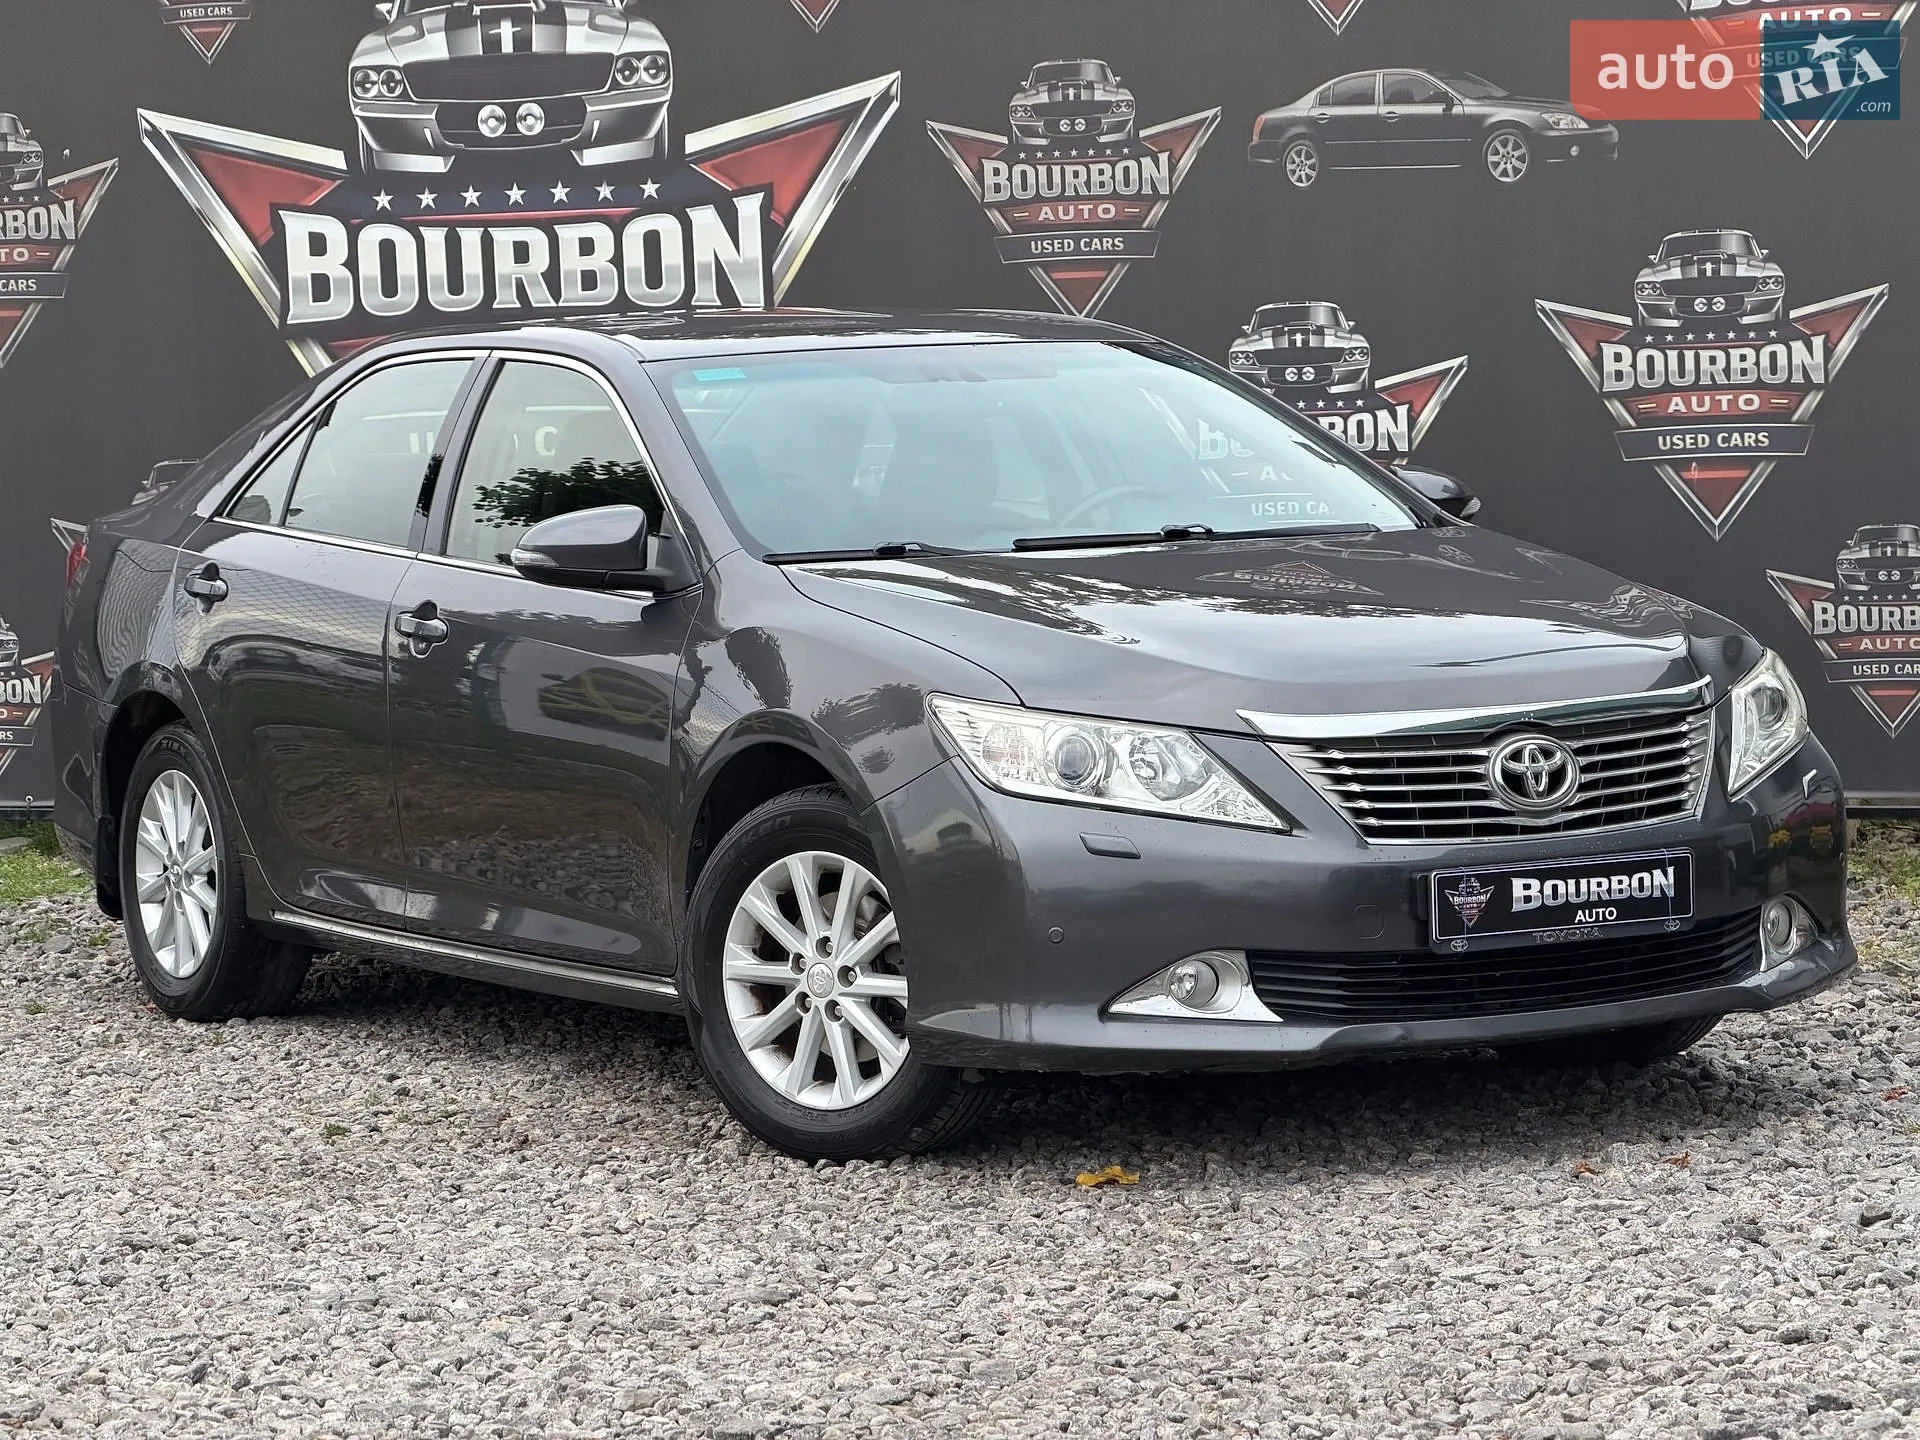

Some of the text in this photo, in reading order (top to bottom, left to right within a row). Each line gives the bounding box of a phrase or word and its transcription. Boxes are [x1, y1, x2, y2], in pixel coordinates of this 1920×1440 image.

[180, 6, 233, 18] USED CARS
[1757, 7, 1851, 31] AUTO
[981, 151, 1170, 203] BOURBON
[1038, 203, 1117, 221] AUTO
[1030, 237, 1124, 254] USED CARS
[278, 191, 766, 324] BOURBON
[1600, 334, 1826, 392] BOURBON
[1667, 393, 1761, 413] AUTO
[1658, 431, 1769, 450] USED CARS
[1251, 501, 1299, 516] USED
[1852, 664, 1890, 676] USED
[1510, 866, 1675, 913] BOURBON
[1574, 907, 1617, 924] AUTO
[1532, 927, 1604, 944] TOYOTA
